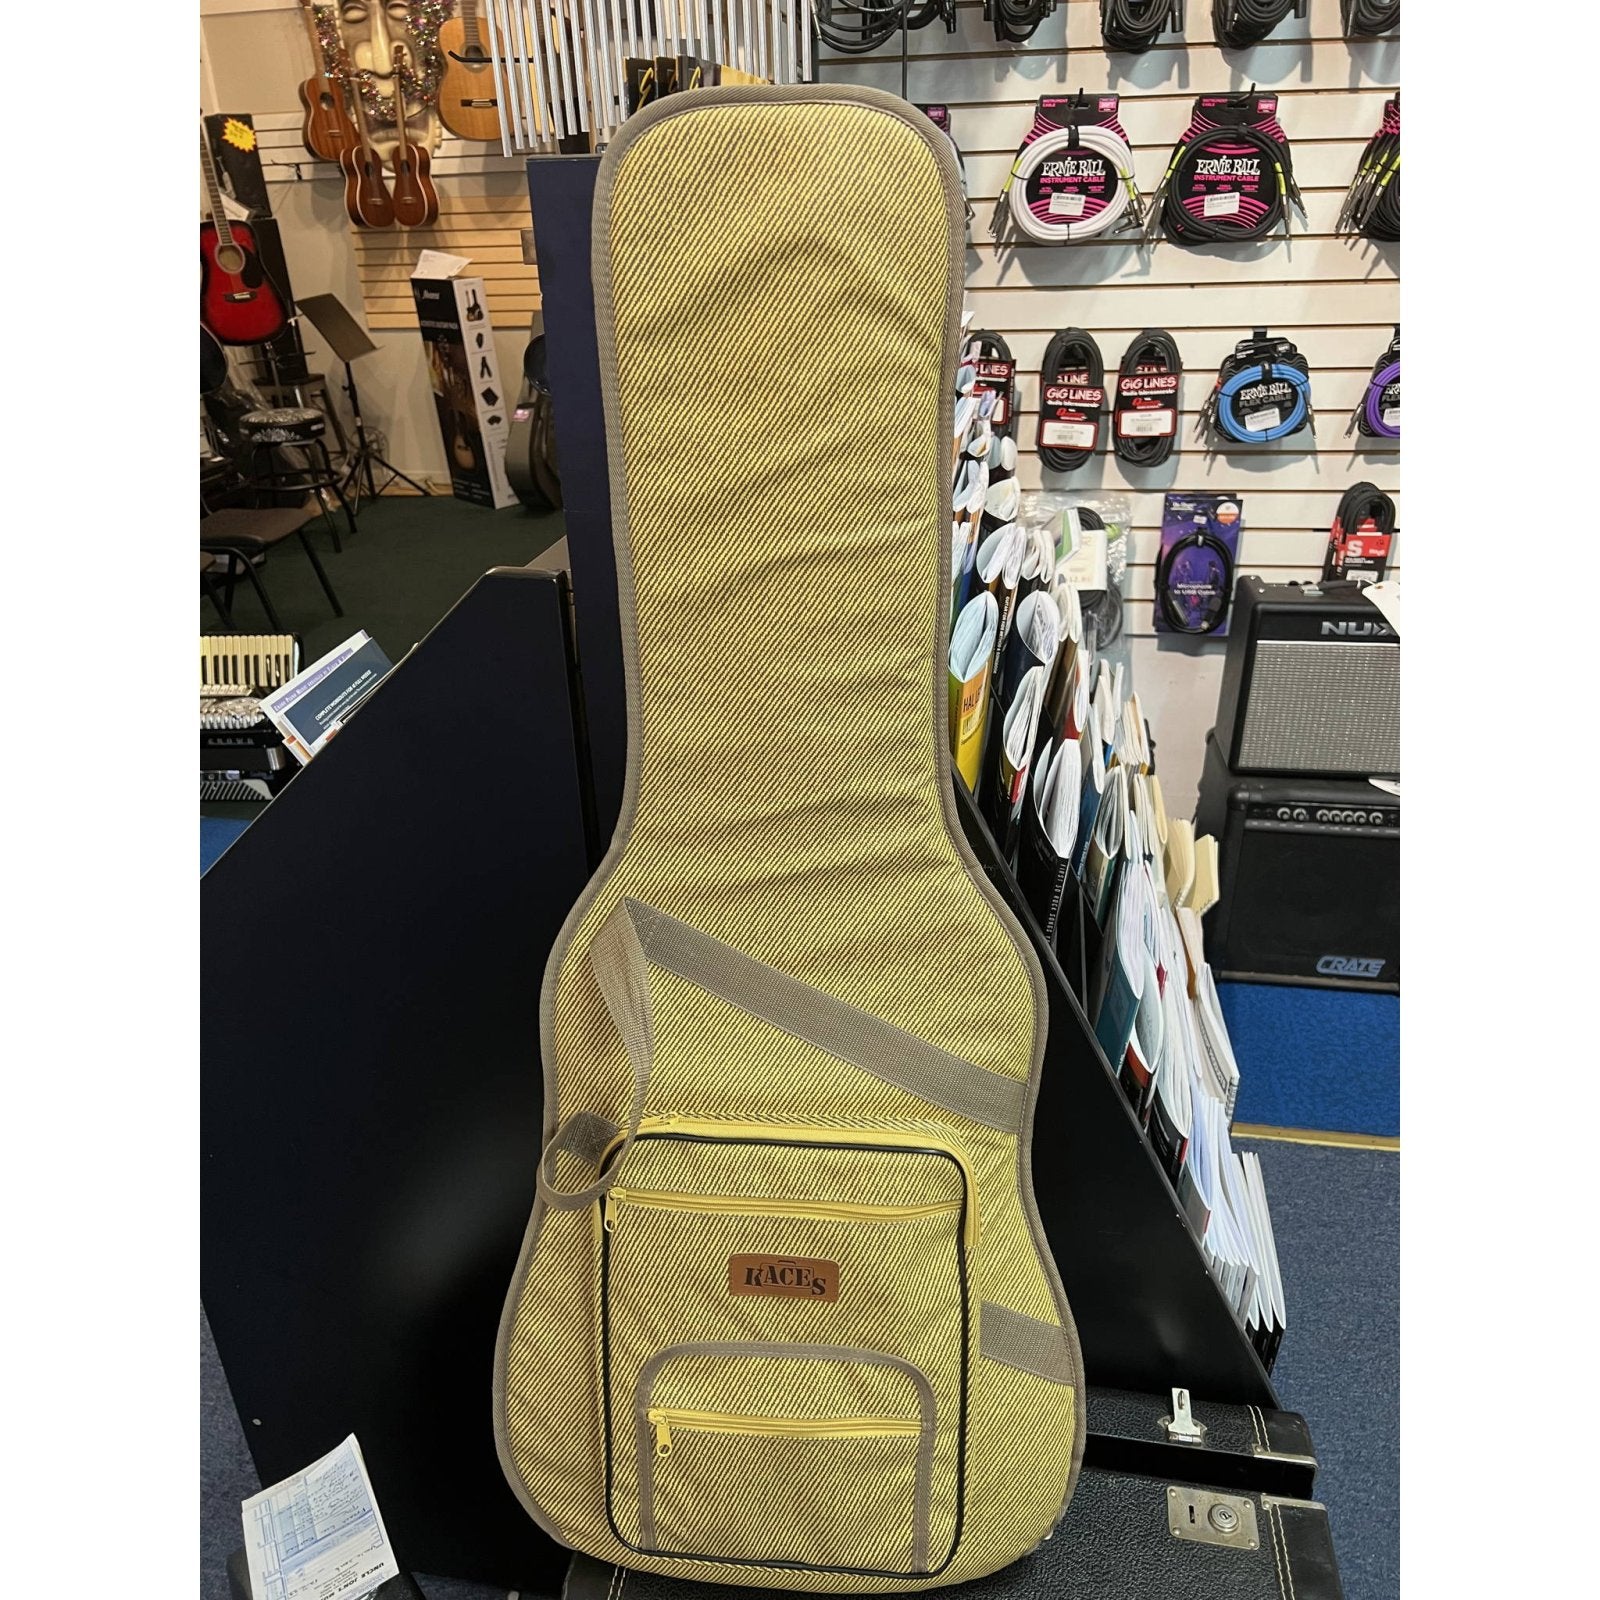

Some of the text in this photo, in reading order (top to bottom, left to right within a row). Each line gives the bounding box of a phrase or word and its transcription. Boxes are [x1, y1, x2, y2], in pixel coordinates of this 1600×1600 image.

[1041, 156, 1106, 178] ERNIE BALL
[1195, 154, 1260, 176] ERNIE BALL
[1040, 176, 1082, 184] INSTRUMENT
[1236, 174, 1259, 182] CABLE
[1269, 382, 1292, 396] BALL
[1315, 955, 1386, 978] CRATE
[744, 1265, 826, 1296] KACES
